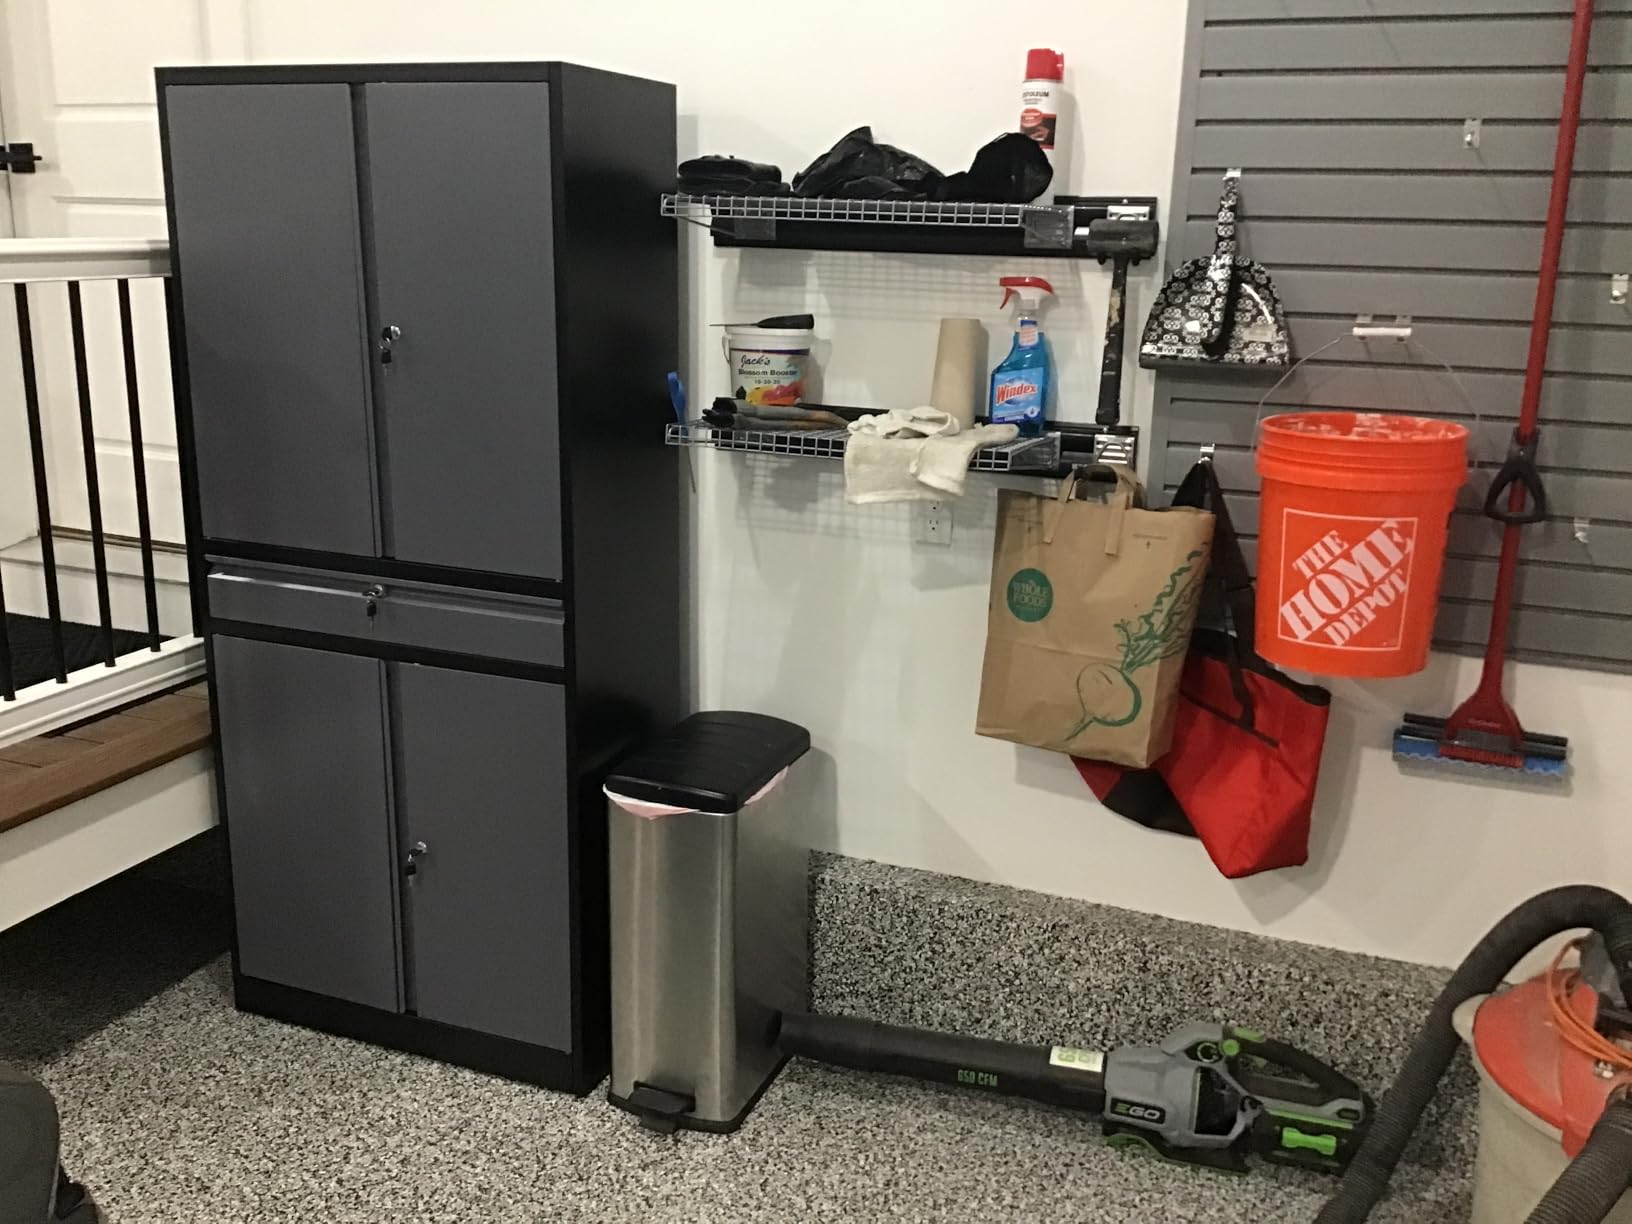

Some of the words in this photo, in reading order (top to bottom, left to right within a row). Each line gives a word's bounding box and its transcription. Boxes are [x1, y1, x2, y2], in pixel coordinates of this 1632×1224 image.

[741, 354, 771, 368] Jack's
[996, 383, 1038, 405] Windex
[1292, 529, 1350, 579] THE
[1280, 520, 1415, 642] HOME
[1324, 567, 1409, 647] DEPOT
[978, 1072, 998, 1087] CFM
[1115, 1103, 1161, 1120] EGO
